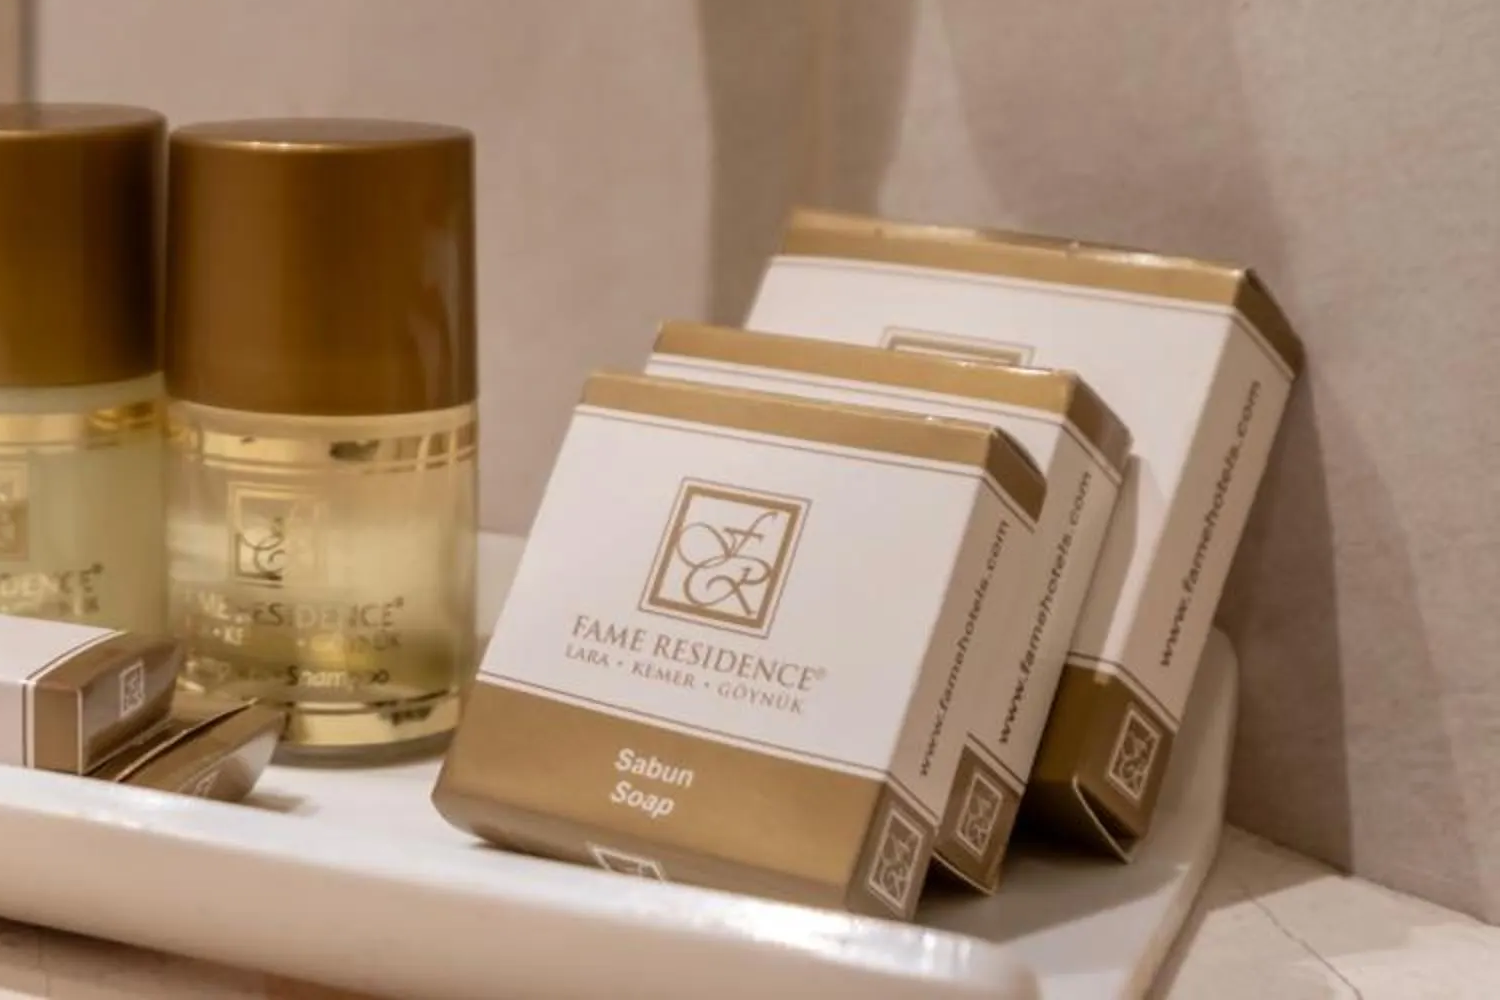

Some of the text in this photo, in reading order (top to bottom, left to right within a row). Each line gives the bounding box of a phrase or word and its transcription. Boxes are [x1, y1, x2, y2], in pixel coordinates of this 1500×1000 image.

[1159, 379, 1262, 668] www.famehotels.com
[571, 613, 648, 653] FAME
[999, 471, 1093, 744] www.famehotels.com
[565, 645, 806, 715] LARA KEMER GÖYNÜK
[919, 519, 1011, 777] www.famehotels.com
[608, 779, 676, 818] Soap
[614, 747, 695, 789] Sabun
